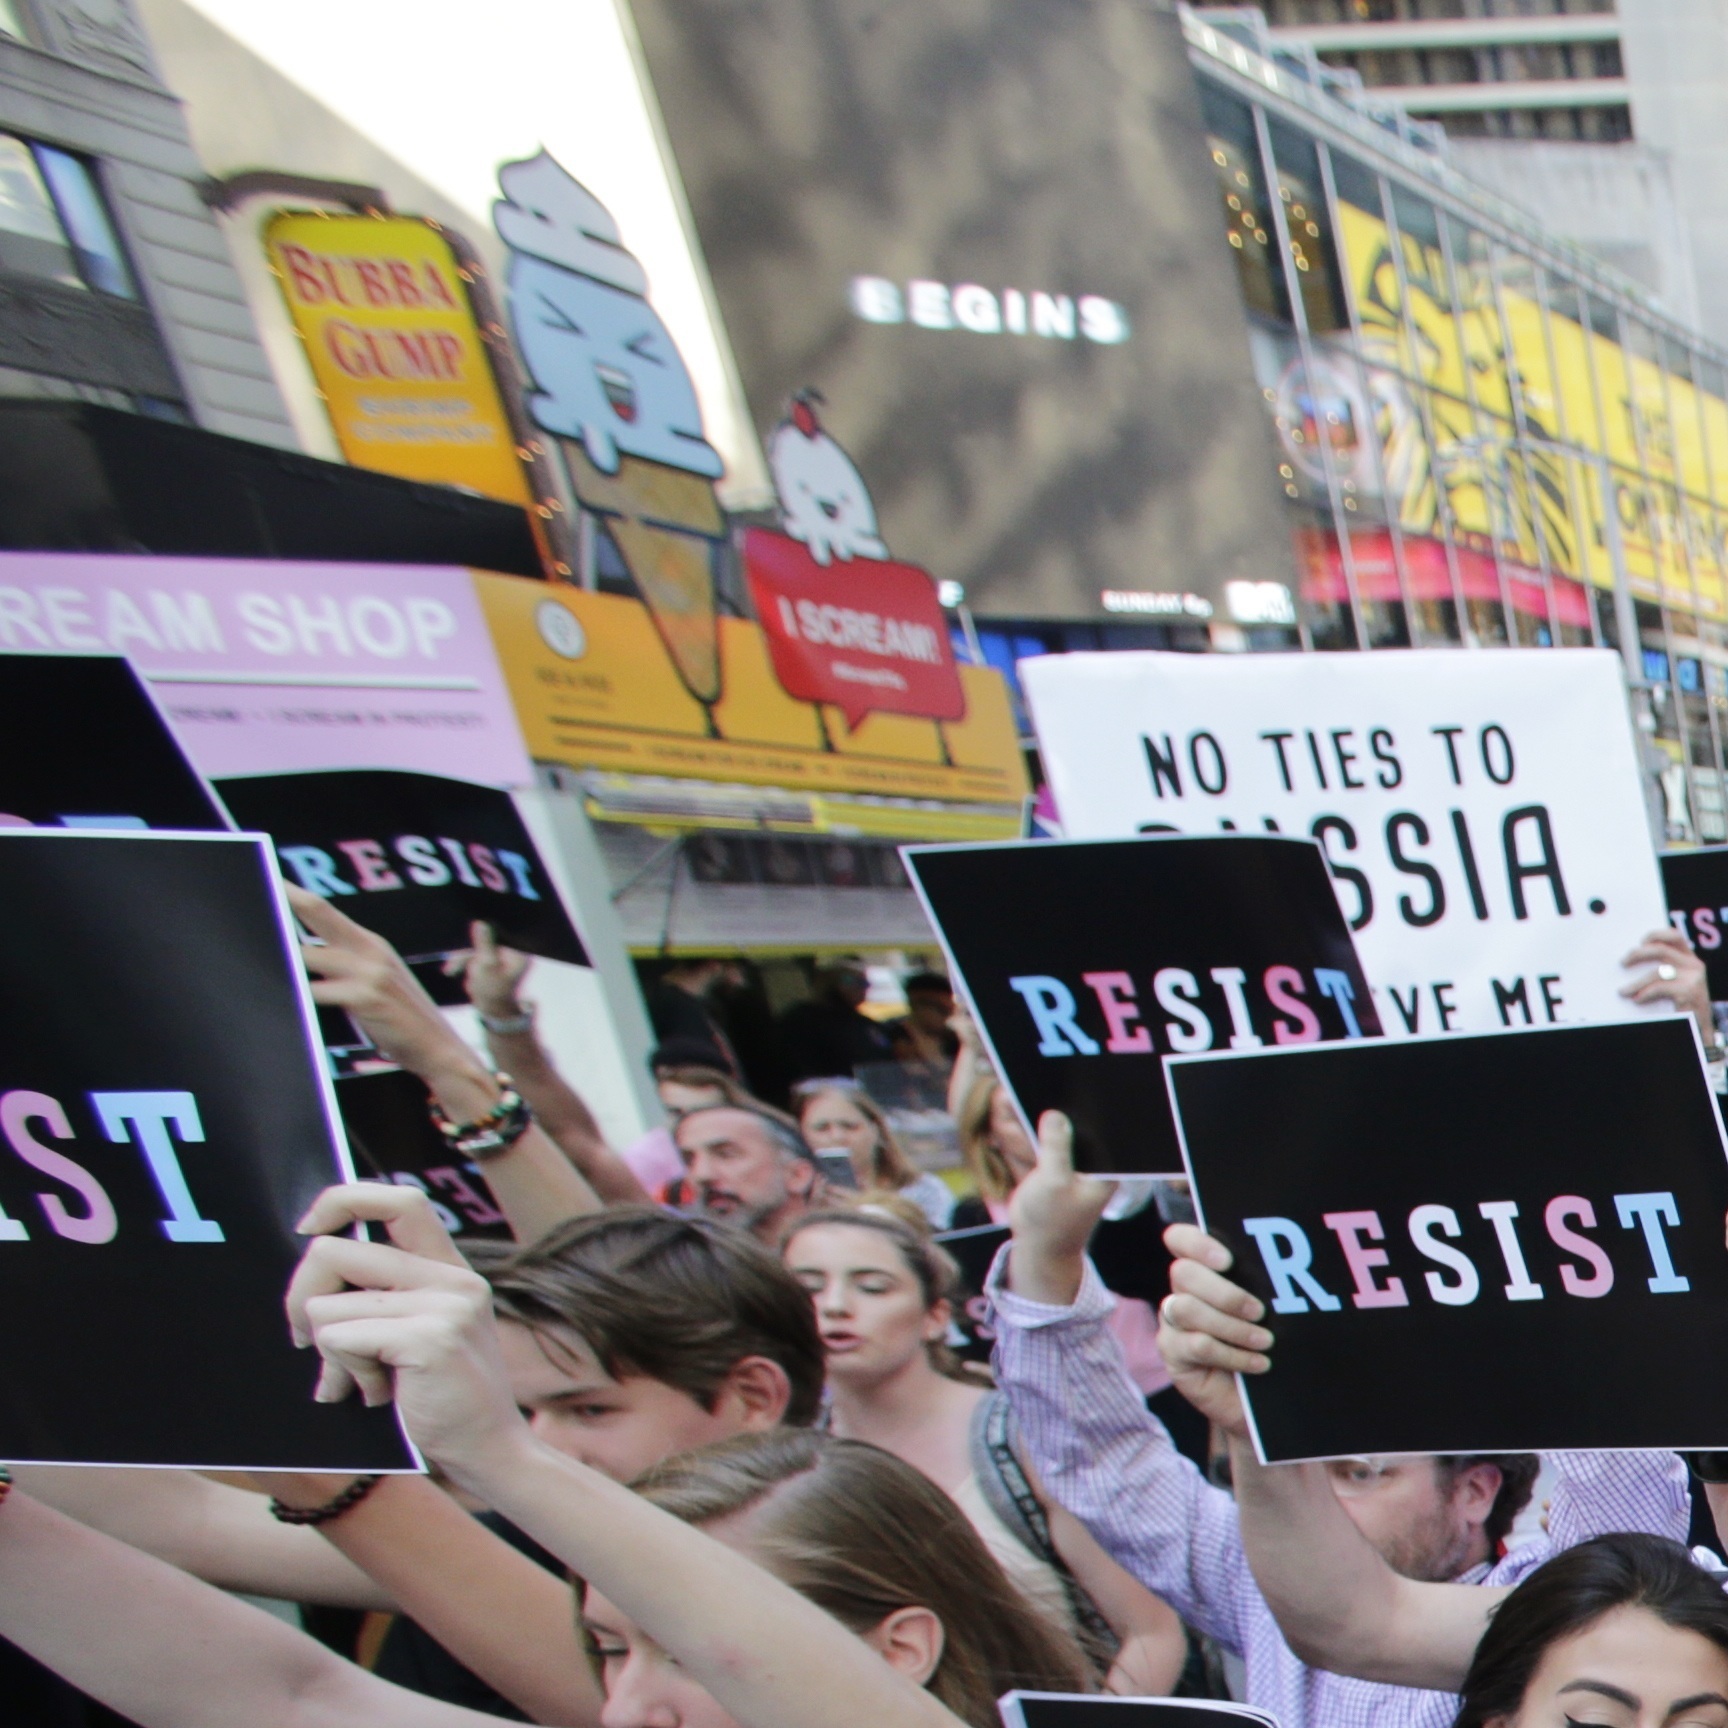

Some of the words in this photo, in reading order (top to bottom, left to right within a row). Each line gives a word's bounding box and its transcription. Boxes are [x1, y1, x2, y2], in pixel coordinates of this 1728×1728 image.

[277, 242, 460, 311] BUBBA
[853, 276, 1129, 345] BEGINS
[325, 318, 465, 382] GUMP
[240, 592, 455, 660] SHOP
[1141, 731, 1228, 799] NO
[1261, 728, 1404, 792] TIES
[1432, 724, 1516, 786] TO
[278, 834, 540, 902] RESIST
[1136, 804, 1607, 931] SSIA.
[1010, 965, 1360, 1058] RESIST
[0, 1090, 226, 1245] ST
[1242, 1191, 1690, 1315] RESIST
